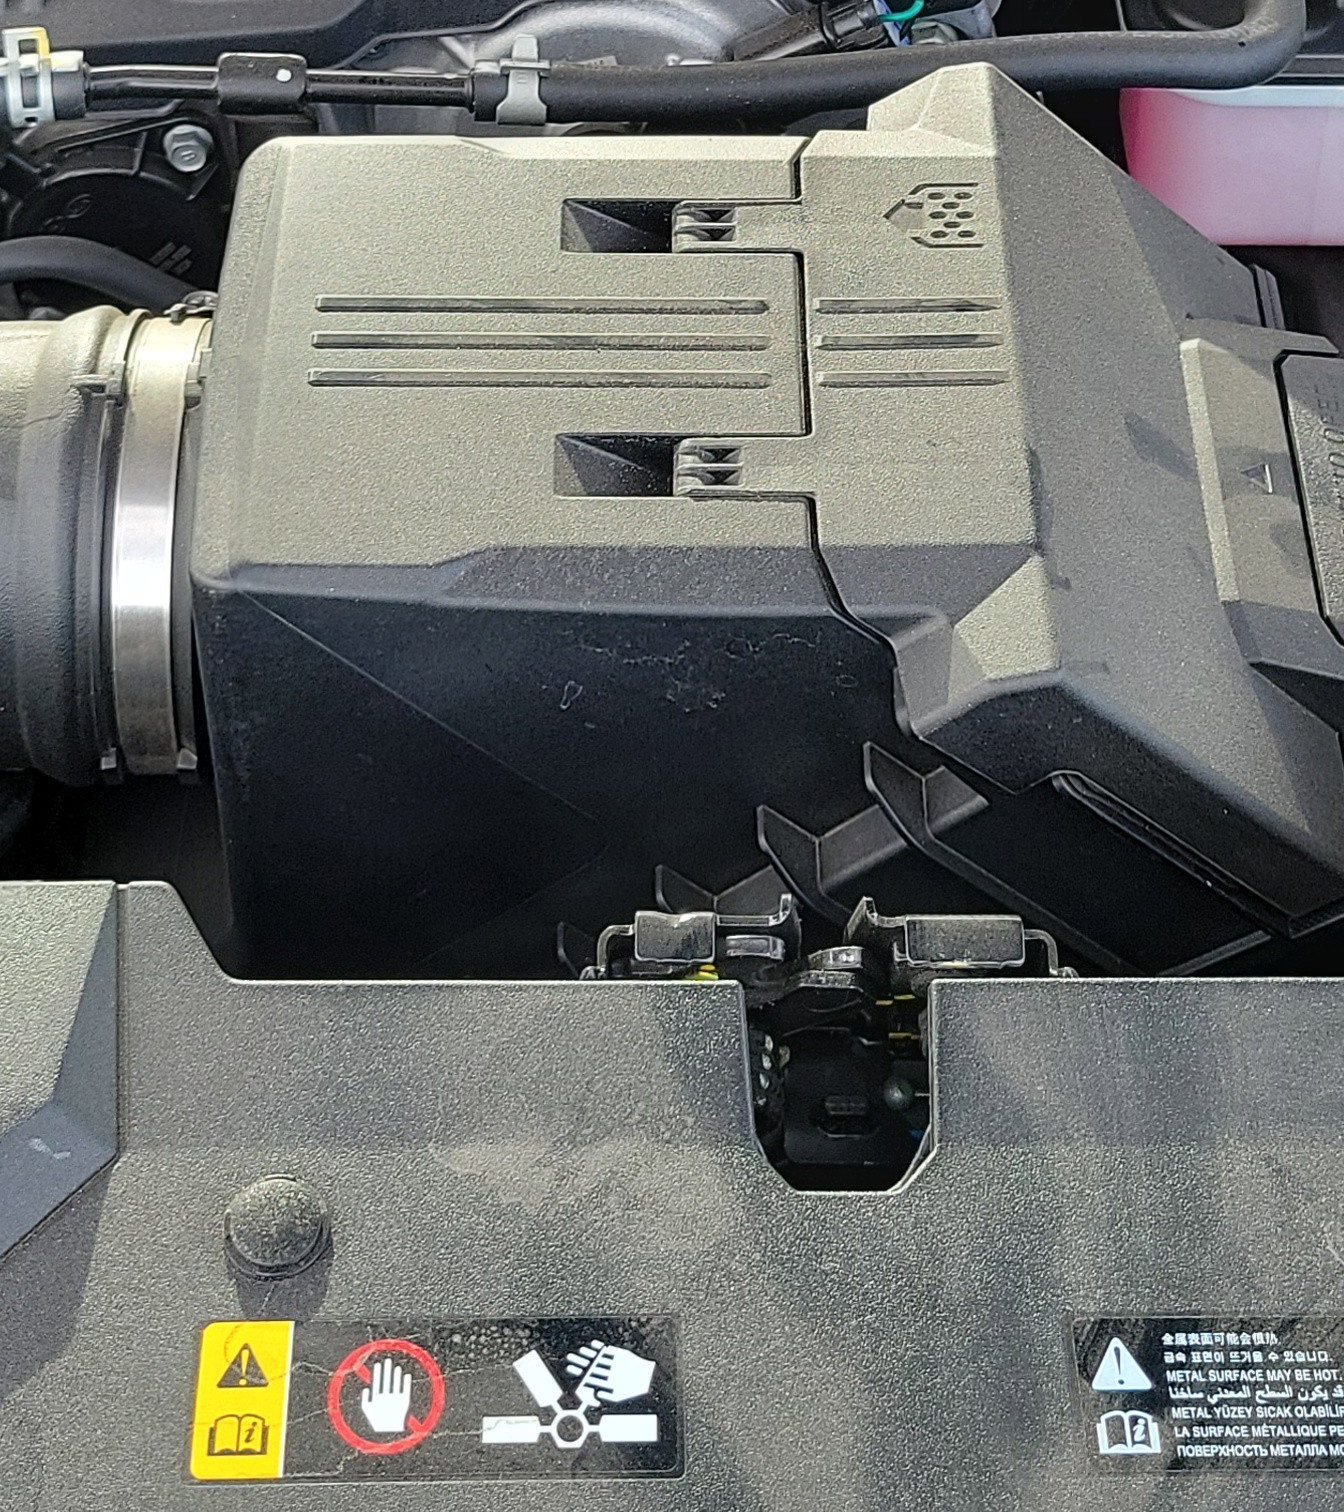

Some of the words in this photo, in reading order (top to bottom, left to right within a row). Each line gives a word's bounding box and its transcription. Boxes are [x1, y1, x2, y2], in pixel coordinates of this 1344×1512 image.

[1191, 1350, 1225, 1364] 표면이
[1268, 1351, 1279, 1362] 수
[1283, 1350, 1333, 1363] 있습니다.
[1165, 1369, 1207, 1382] METAL
[1208, 1369, 1264, 1382] SURFACE
[1267, 1369, 1291, 1381] MAY
[1295, 1369, 1311, 1381] BE
[1313, 1369, 1343, 1381] HOT.
[1172, 1406, 1213, 1419] METAL
[1214, 1404, 1253, 1419] YÜZEY
[1255, 1406, 1292, 1418] SICAK
[1174, 1426, 1191, 1438] LA
[1192, 1425, 1252, 1438] SURFACE
[1251, 1422, 1327, 1438] MÉTALLIQUE
[1176, 1444, 1268, 1458] ПОВЕРХНОСТЬ
[1270, 1444, 1328, 1457] МЕТАЛЛА
